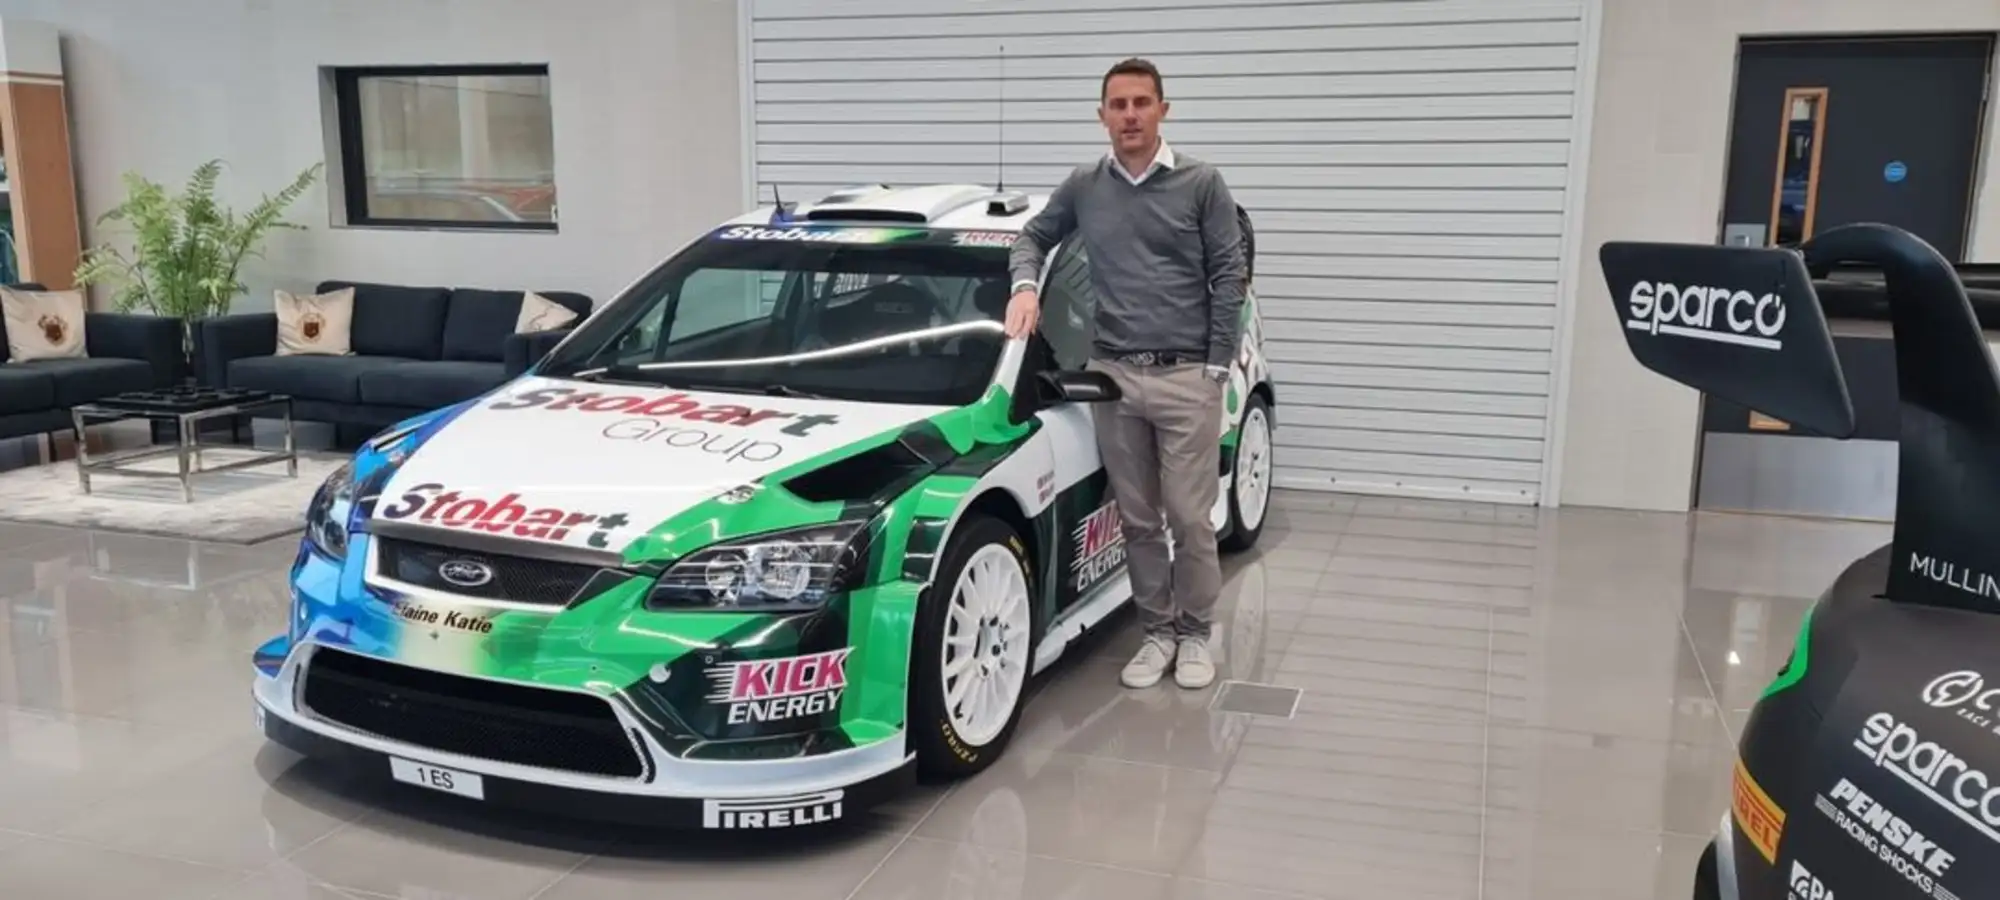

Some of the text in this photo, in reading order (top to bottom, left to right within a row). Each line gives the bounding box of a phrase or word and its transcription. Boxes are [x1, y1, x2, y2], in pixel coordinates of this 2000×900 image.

[1629, 280, 1786, 336] sparco
[489, 388, 839, 437] Stobart
[602, 418, 783, 463] Group
[383, 482, 629, 549] Stobart
[443, 610, 493, 634] Katie
[731, 651, 847, 699] KICK
[727, 689, 844, 725] ENERGY
[417, 767, 455, 790] 1 ES
[703, 788, 844, 829] PIRELLI
[1829, 777, 1956, 878] PENSKE
[1834, 810, 1878, 853] RACING
[1879, 844, 1933, 894] SHOCKS
